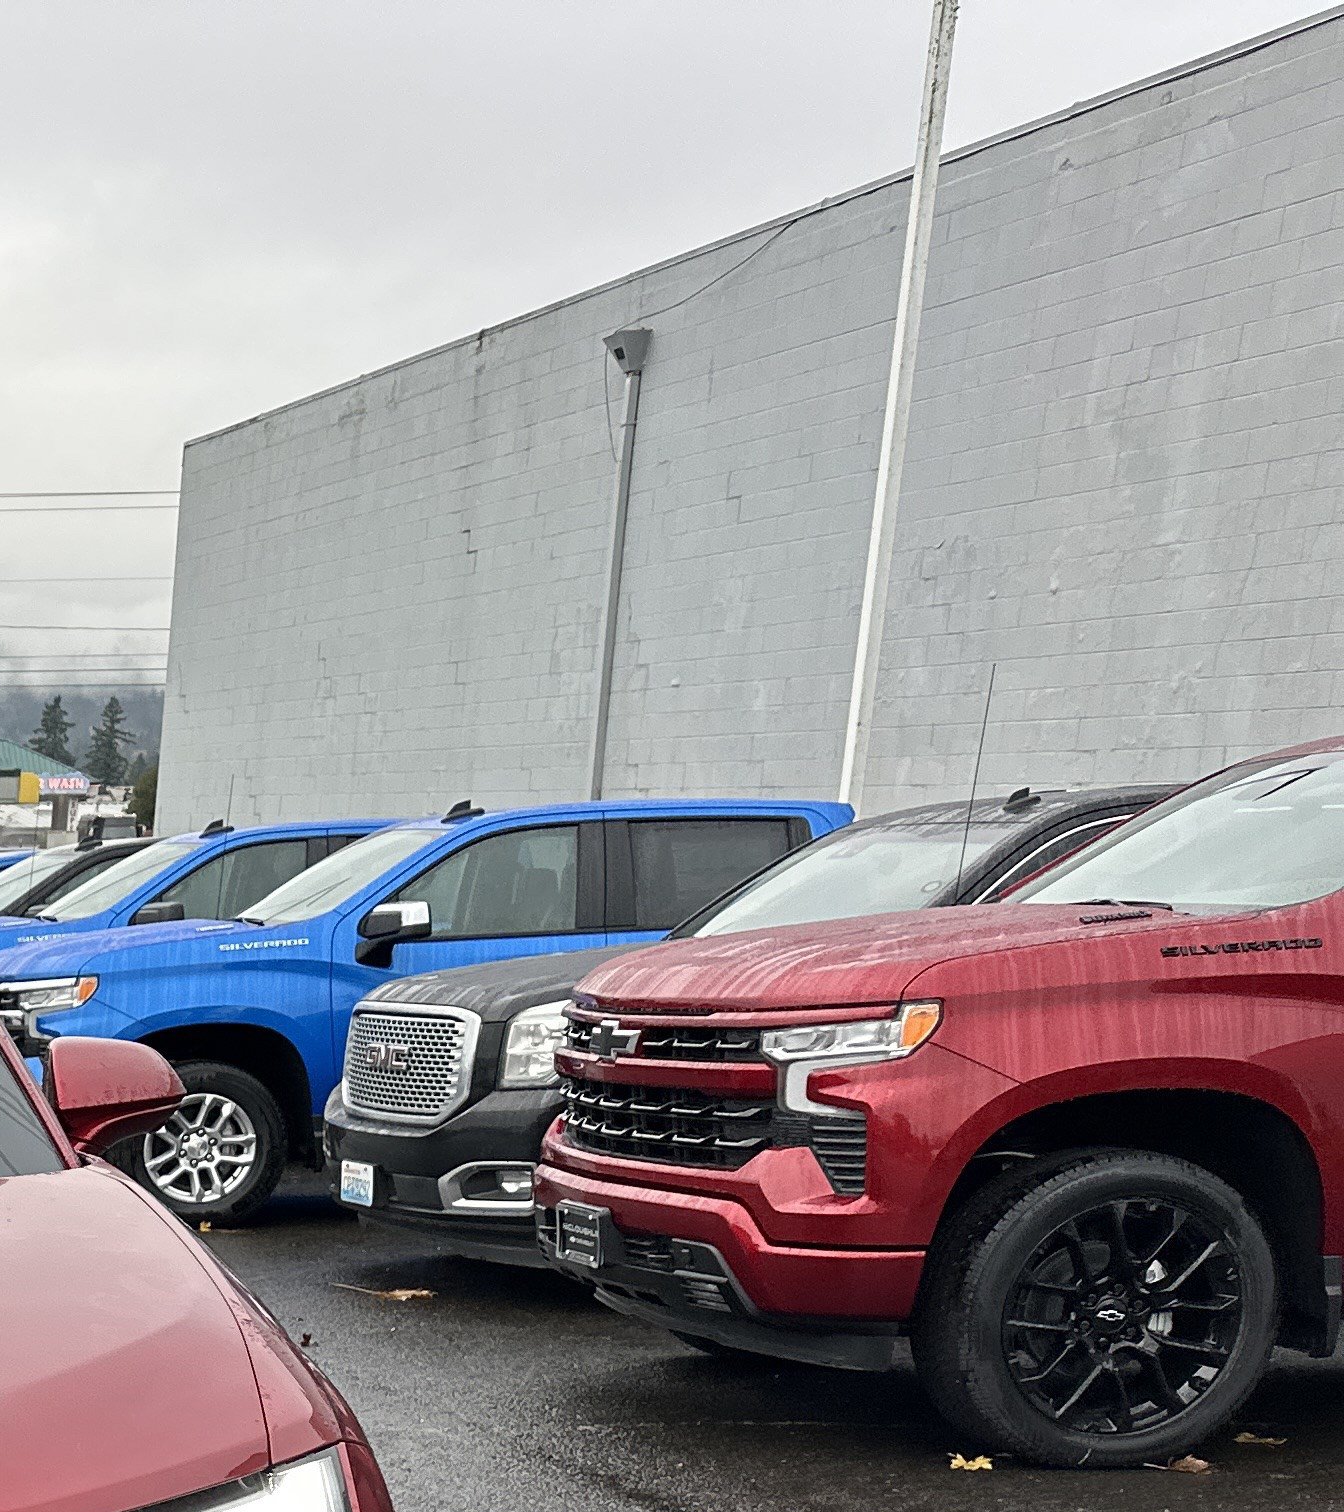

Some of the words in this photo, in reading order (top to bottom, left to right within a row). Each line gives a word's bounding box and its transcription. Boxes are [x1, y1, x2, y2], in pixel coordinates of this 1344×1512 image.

[48, 778, 84, 790] WASH
[219, 938, 309, 952] SILVERADO
[1161, 938, 1323, 957] SILVERADO
[365, 1043, 408, 1071] GMC
